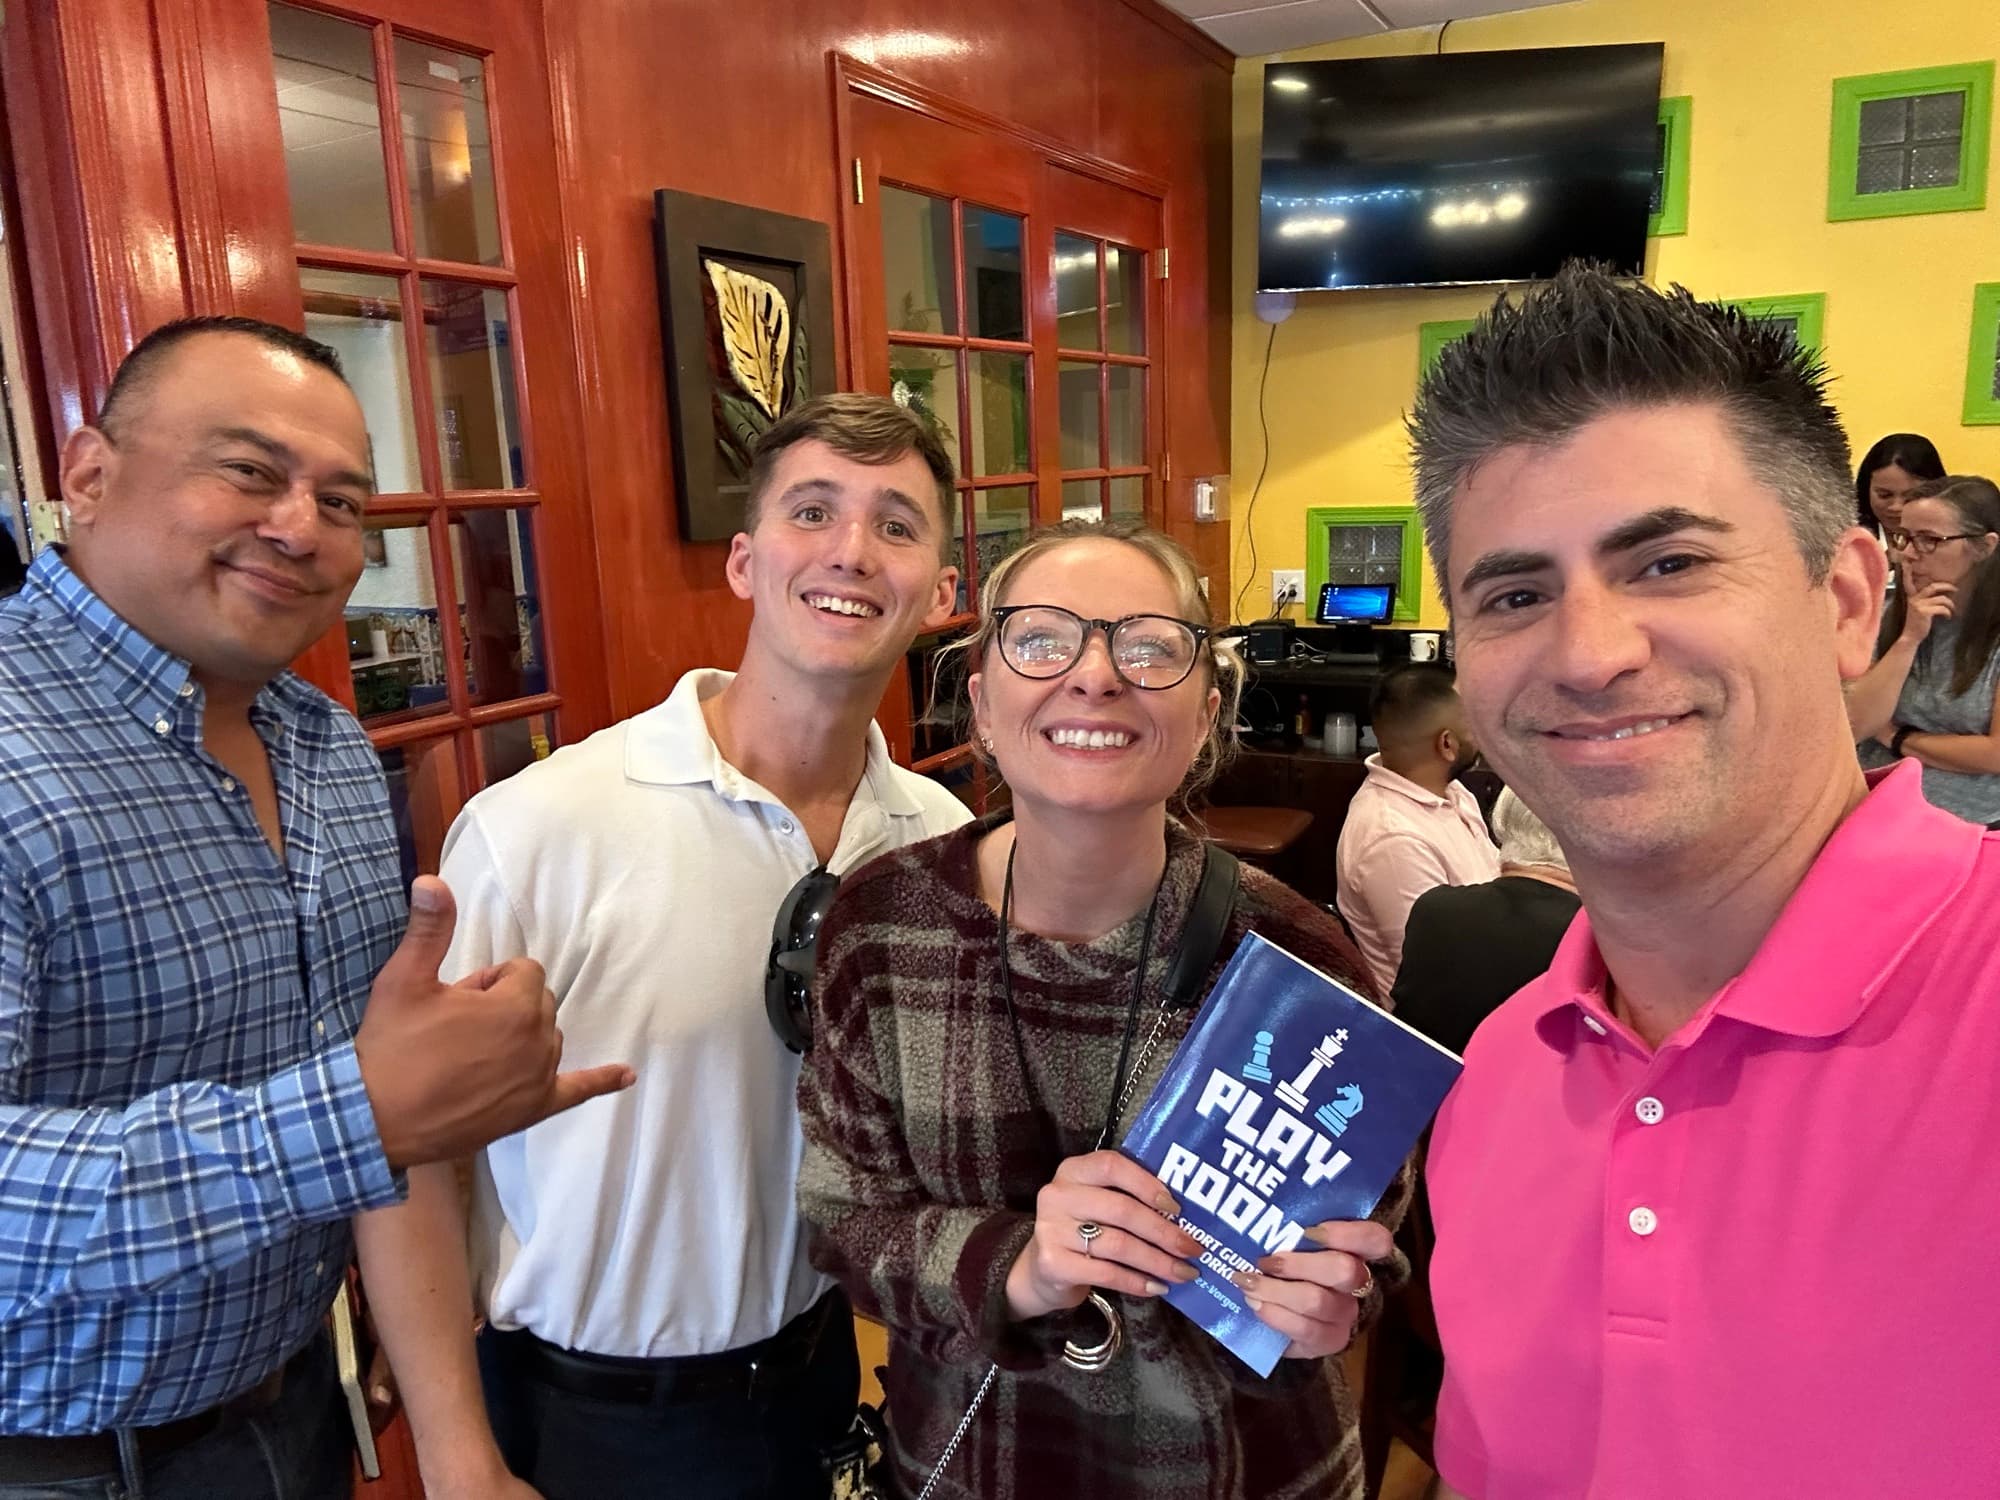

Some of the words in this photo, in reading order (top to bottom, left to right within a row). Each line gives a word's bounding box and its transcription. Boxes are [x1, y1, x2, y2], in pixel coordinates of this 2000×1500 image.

[1195, 1067, 1353, 1189] PLAY
[1220, 1137, 1288, 1198] THE
[1156, 1141, 1305, 1254] ROOM
[1178, 1217, 1224, 1252] SHORT
